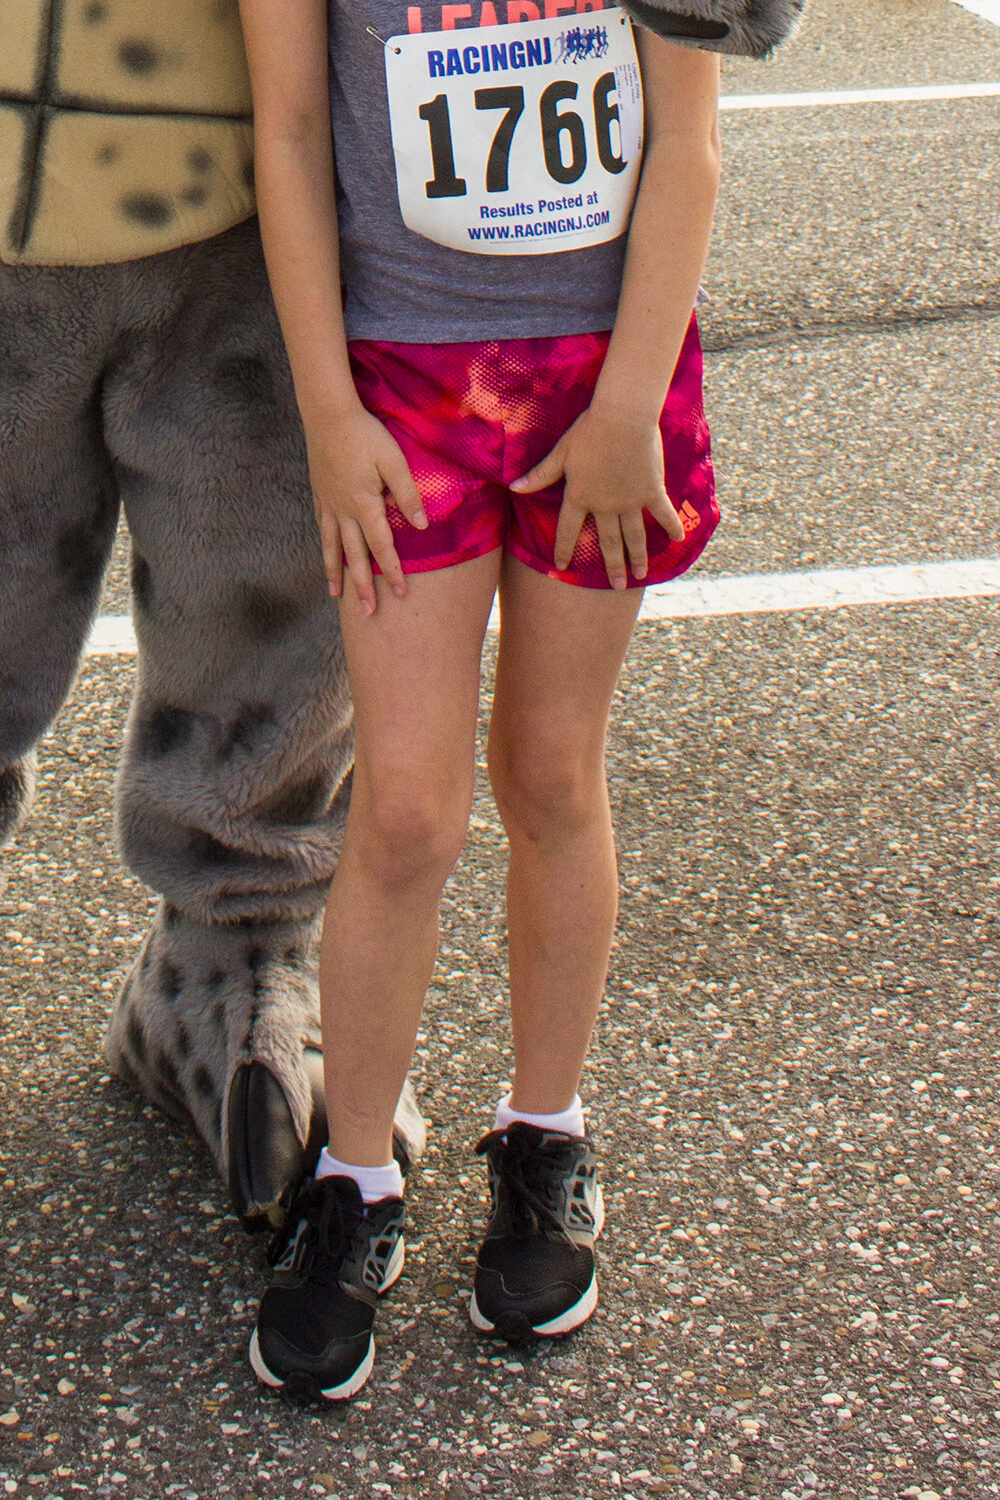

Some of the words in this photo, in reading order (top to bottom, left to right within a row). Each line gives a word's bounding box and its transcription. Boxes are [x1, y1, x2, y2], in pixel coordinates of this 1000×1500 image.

[427, 36, 552, 78] RACINGNJ
[418, 71, 629, 199] 1766
[480, 202, 534, 219] Results
[538, 193, 583, 213] Posted
[587, 191, 599, 205] at
[467, 210, 610, 240] WWW.RACINGNJ.COM
